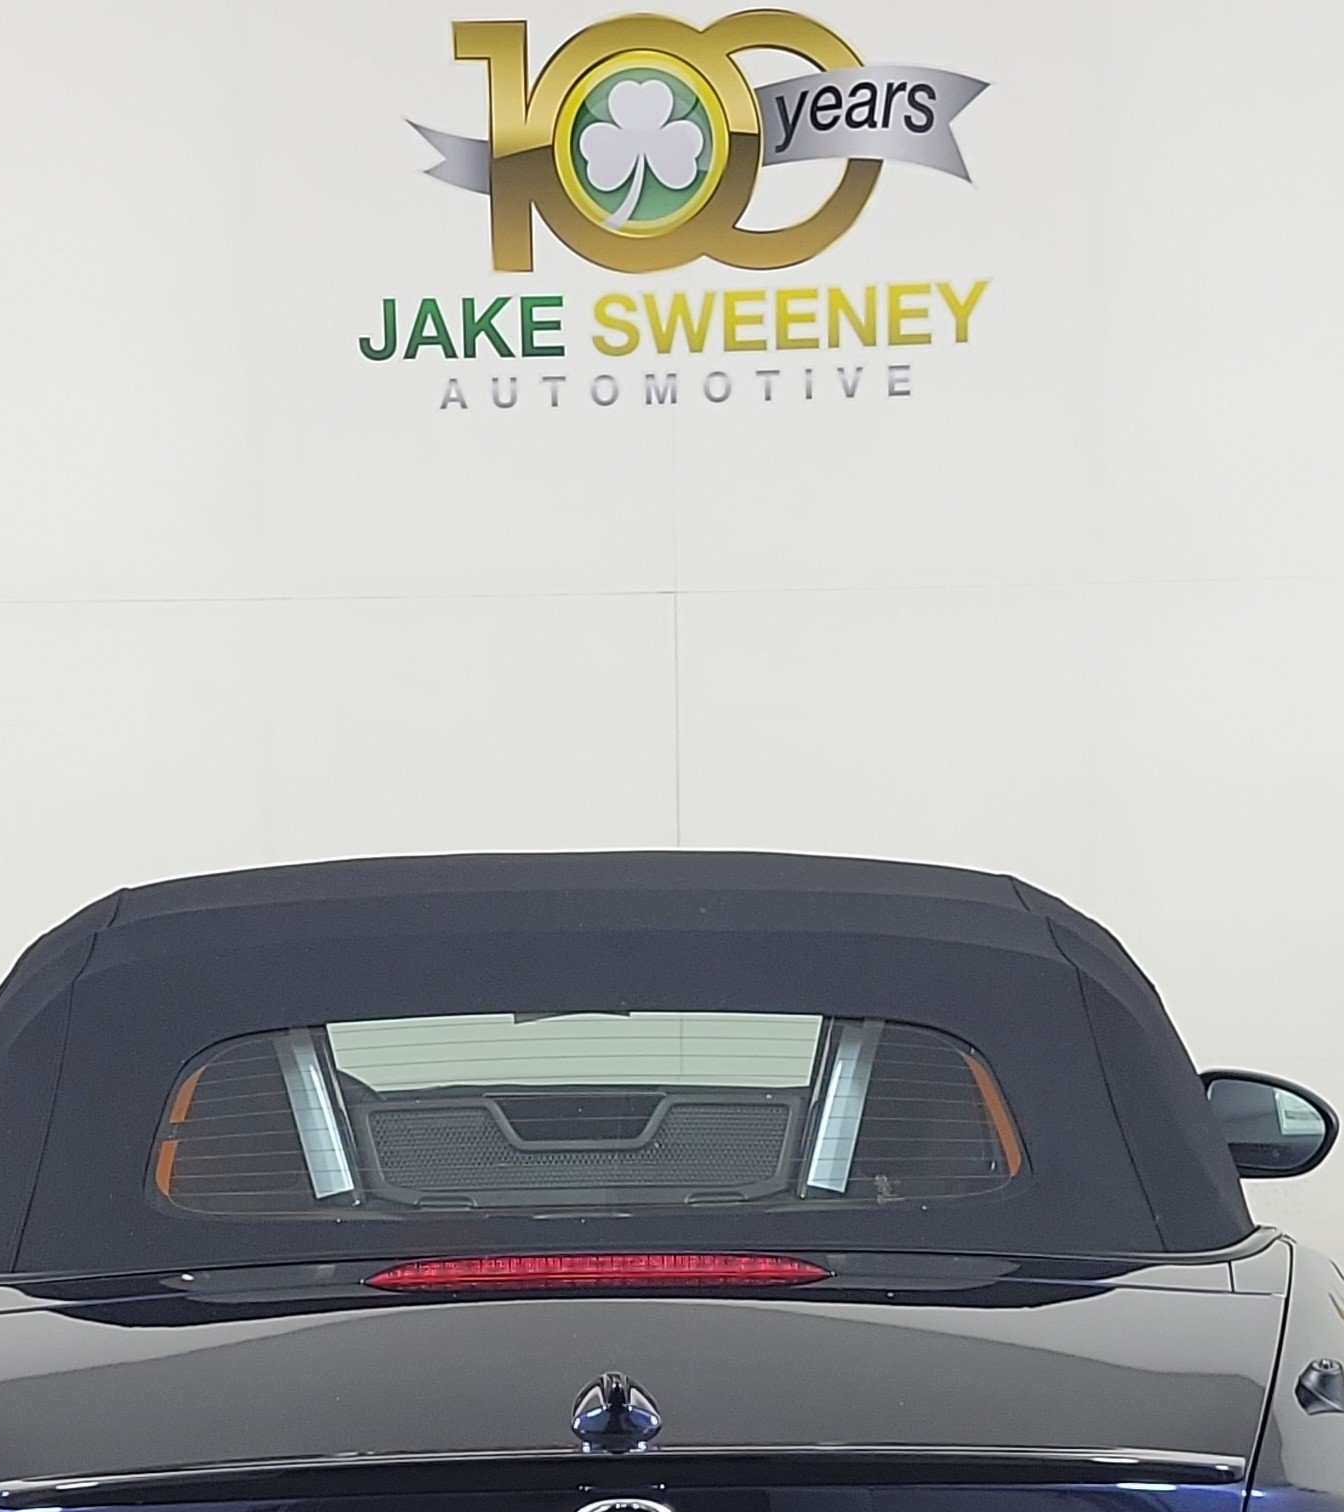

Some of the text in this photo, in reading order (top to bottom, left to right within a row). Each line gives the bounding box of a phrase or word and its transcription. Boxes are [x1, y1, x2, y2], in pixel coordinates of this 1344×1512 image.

[452, 9, 938, 273] 100 years
[359, 280, 989, 361] JAKE SWEENEY
[440, 364, 913, 411] AUTOMOTIVE
